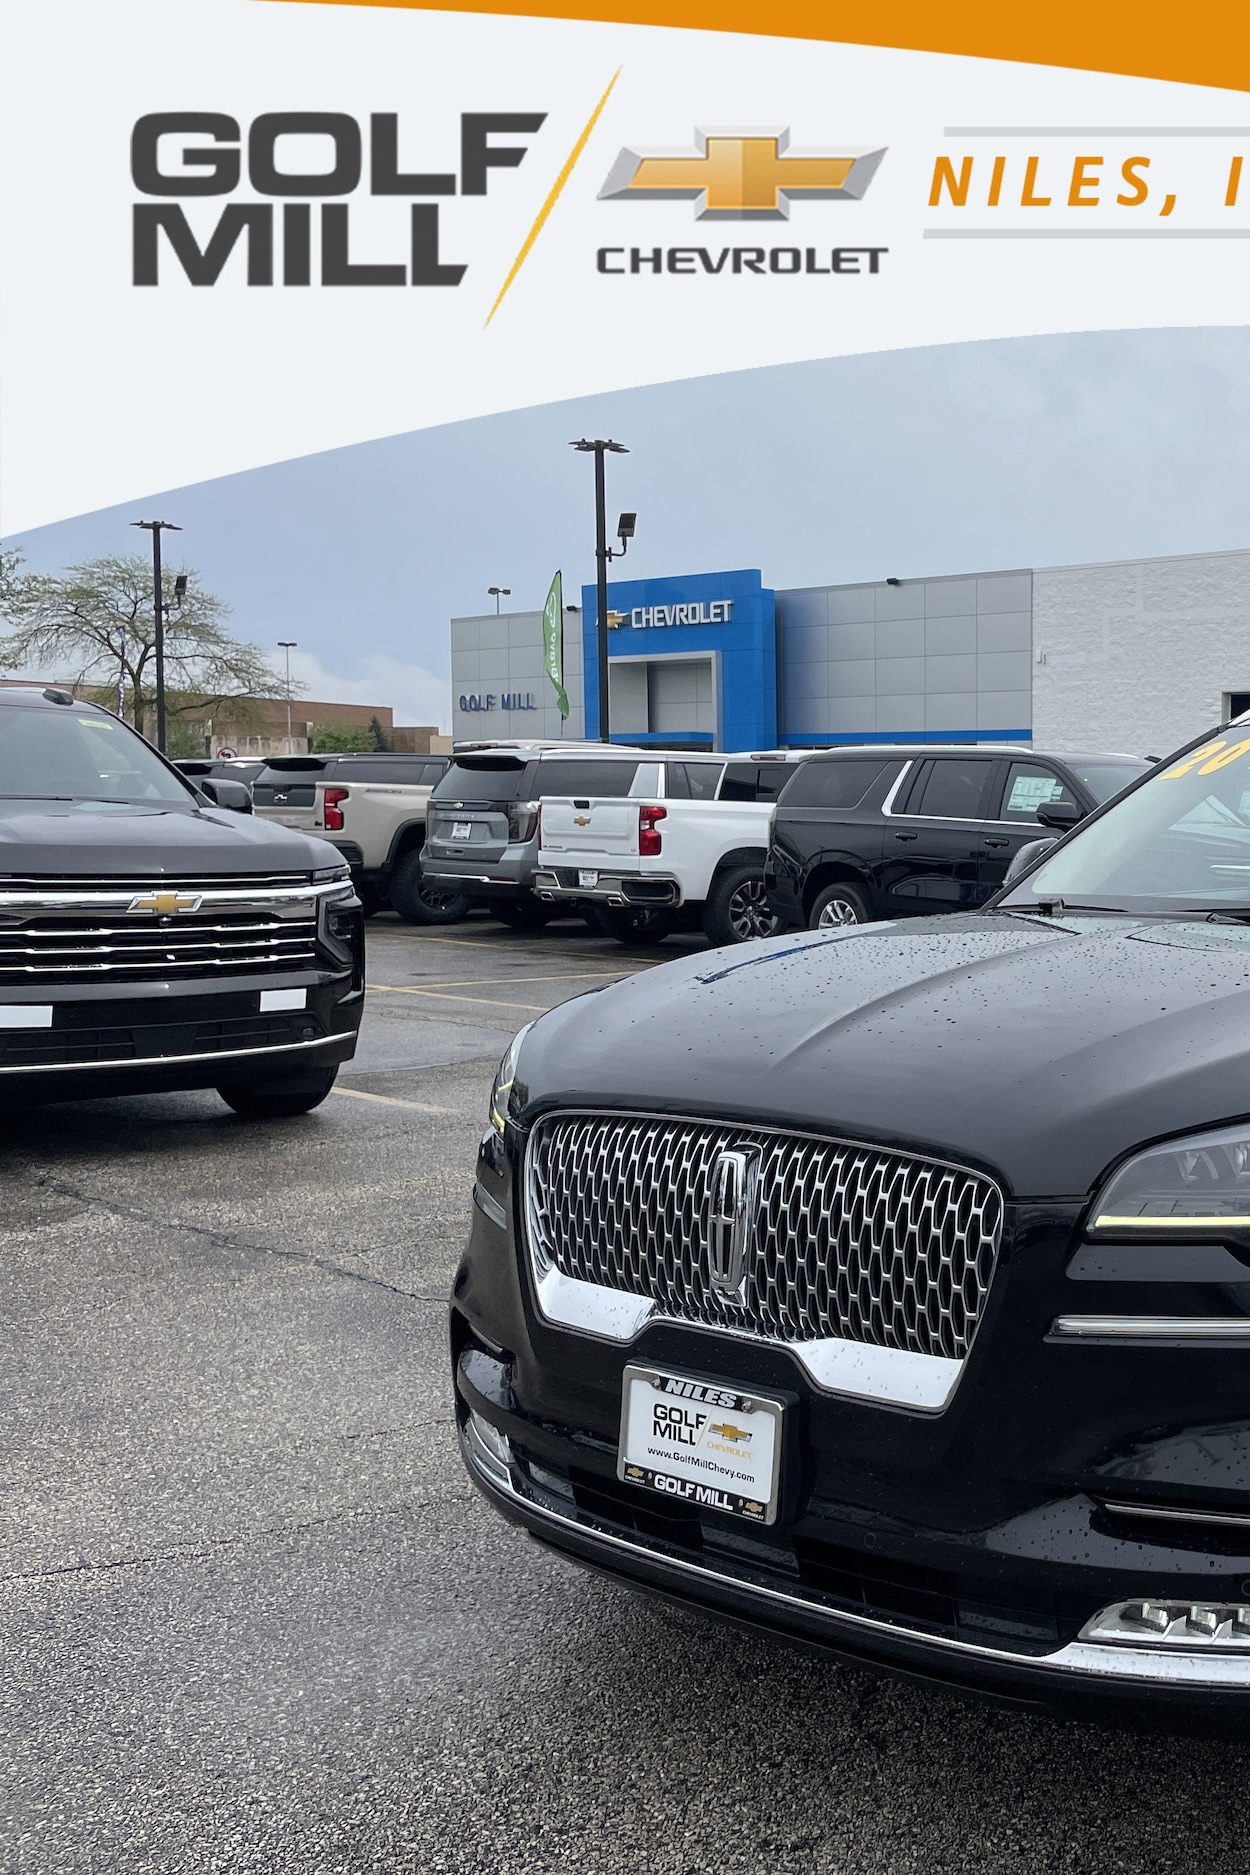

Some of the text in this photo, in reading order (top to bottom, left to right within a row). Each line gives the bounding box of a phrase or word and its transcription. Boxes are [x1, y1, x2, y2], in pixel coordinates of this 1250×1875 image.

[631, 599, 735, 629] CHEVROLET
[459, 692, 537, 712] GOLF MILL
[665, 1379, 738, 1409] NILES
[653, 1403, 708, 1430] GOLF
[653, 1419, 697, 1446] MILL
[706, 1441, 753, 1460] CHEVROLET
[647, 1446, 755, 1484] www.GolfMillChevy.com
[653, 1474, 734, 1511] GOLF MILL
